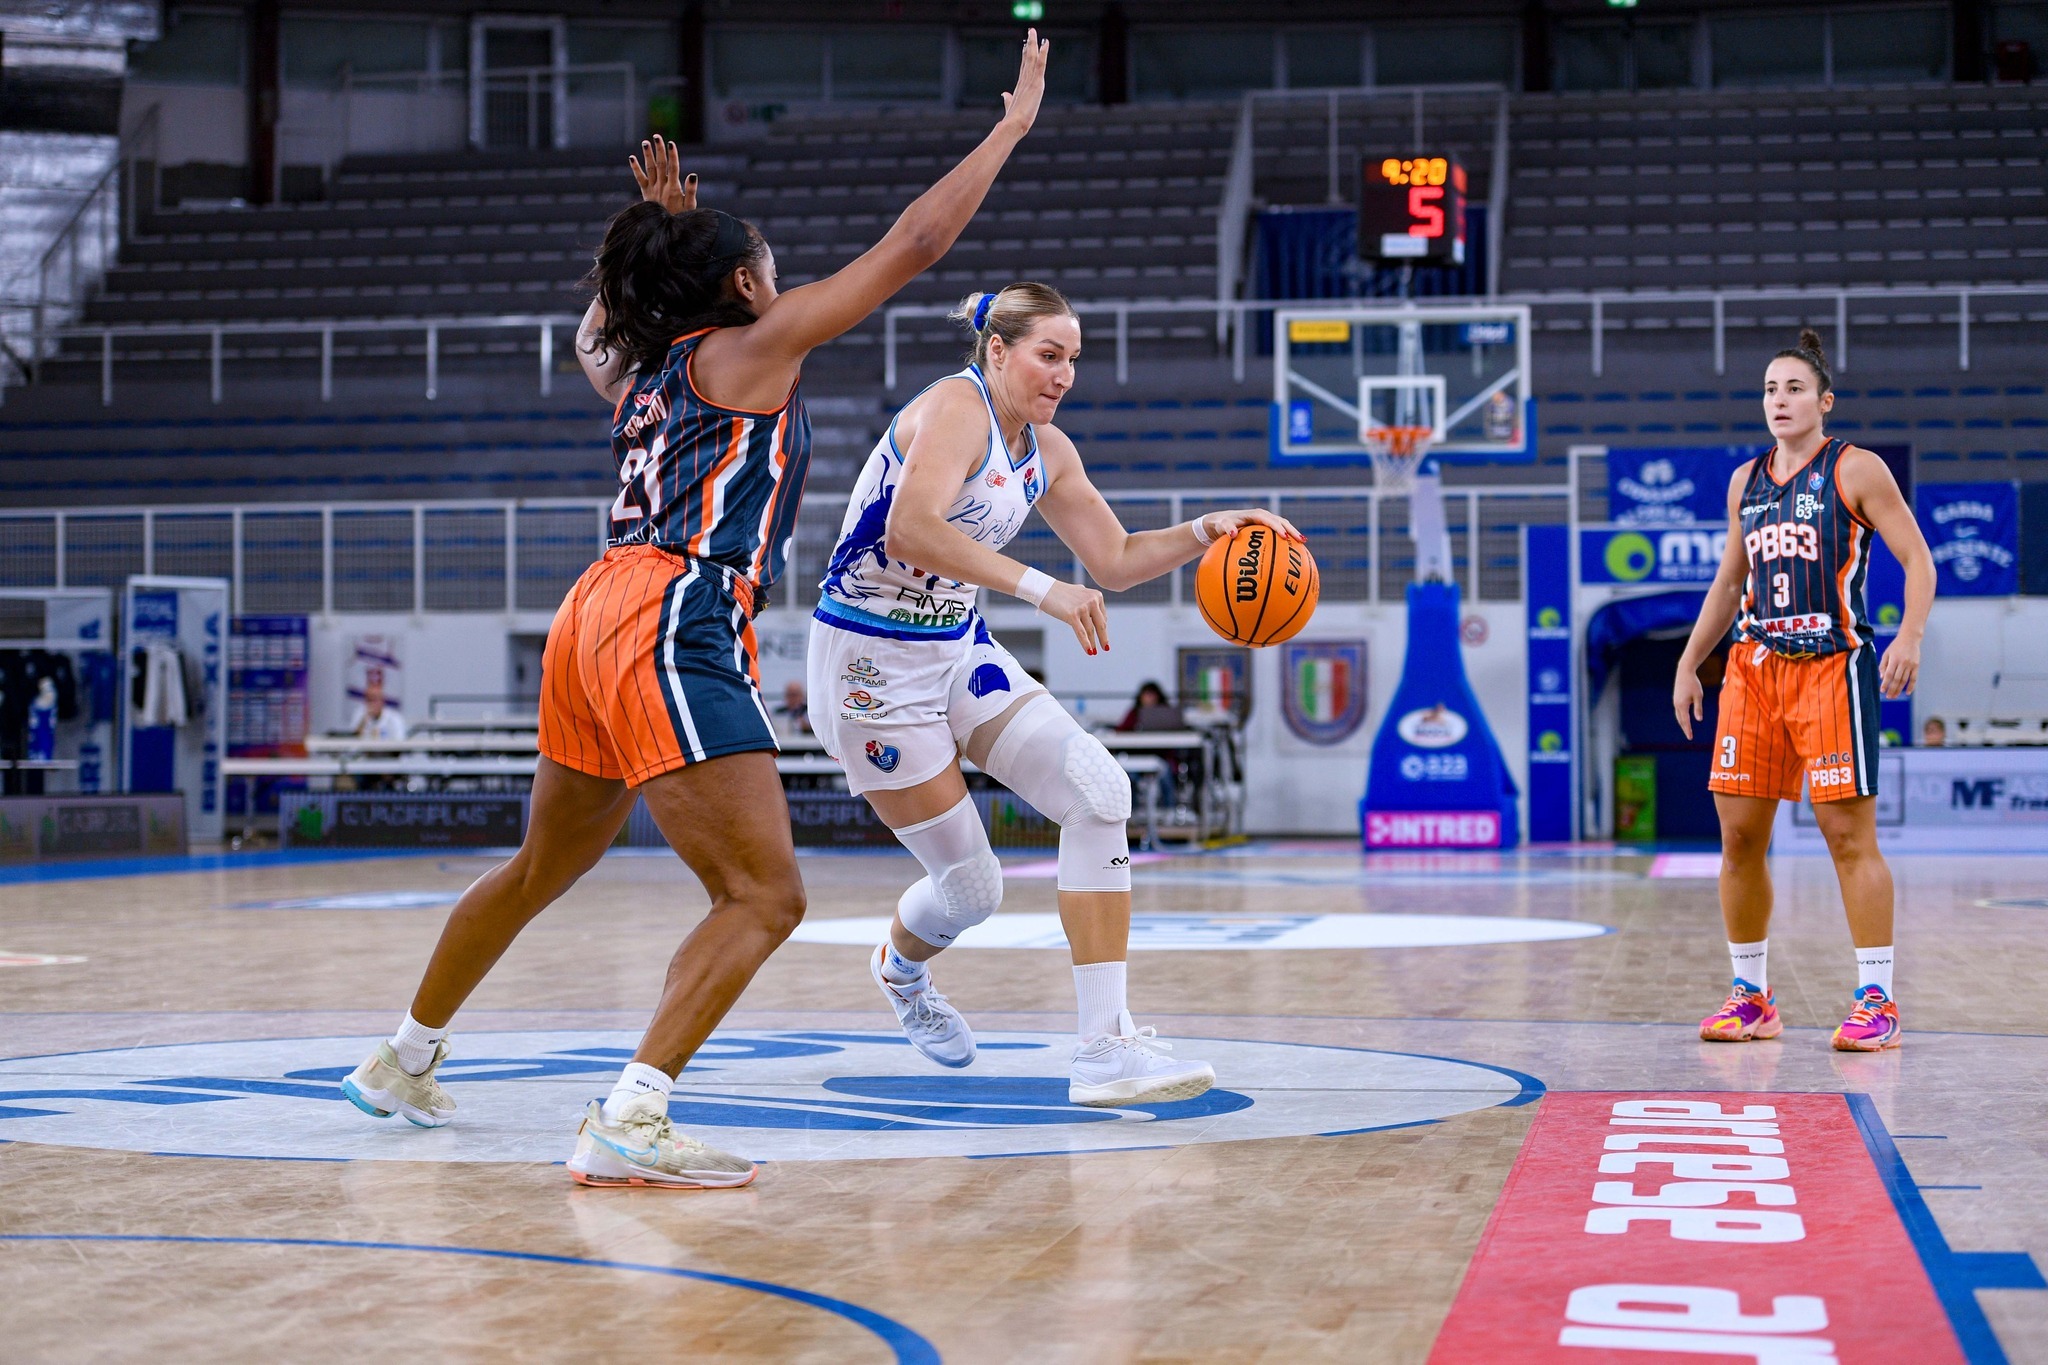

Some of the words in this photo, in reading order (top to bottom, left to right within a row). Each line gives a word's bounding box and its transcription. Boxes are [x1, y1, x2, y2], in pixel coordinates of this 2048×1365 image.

[1409, 186, 1445, 238] 5
[1796, 493, 1815, 506] PB
[1744, 521, 1819, 570] PB63
[1236, 530, 1266, 603] Wilson
[1772, 572, 1790, 609] 3
[841, 674, 888, 687] PORTAMB
[1720, 735, 1738, 769] 3
[1811, 766, 1852, 788] PB63
[1391, 815, 1497, 845] INTRED
[1583, 1100, 1806, 1243] arcese
